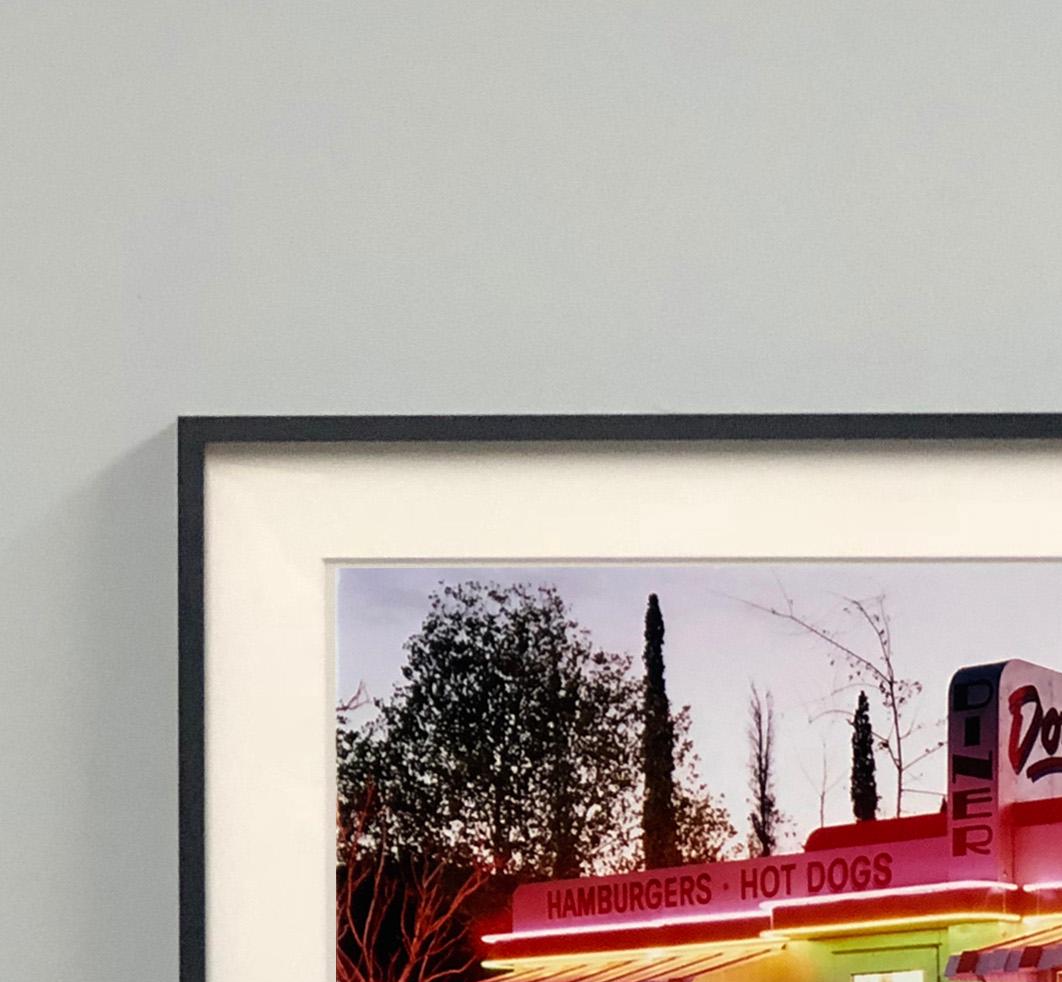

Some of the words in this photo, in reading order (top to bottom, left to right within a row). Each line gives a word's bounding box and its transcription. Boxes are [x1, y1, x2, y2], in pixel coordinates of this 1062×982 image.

[952, 678, 994, 858] DINER
[547, 872, 713, 921] HAMBURGERS
[740, 863, 797, 901] HOT
[807, 851, 893, 894] DOGS
